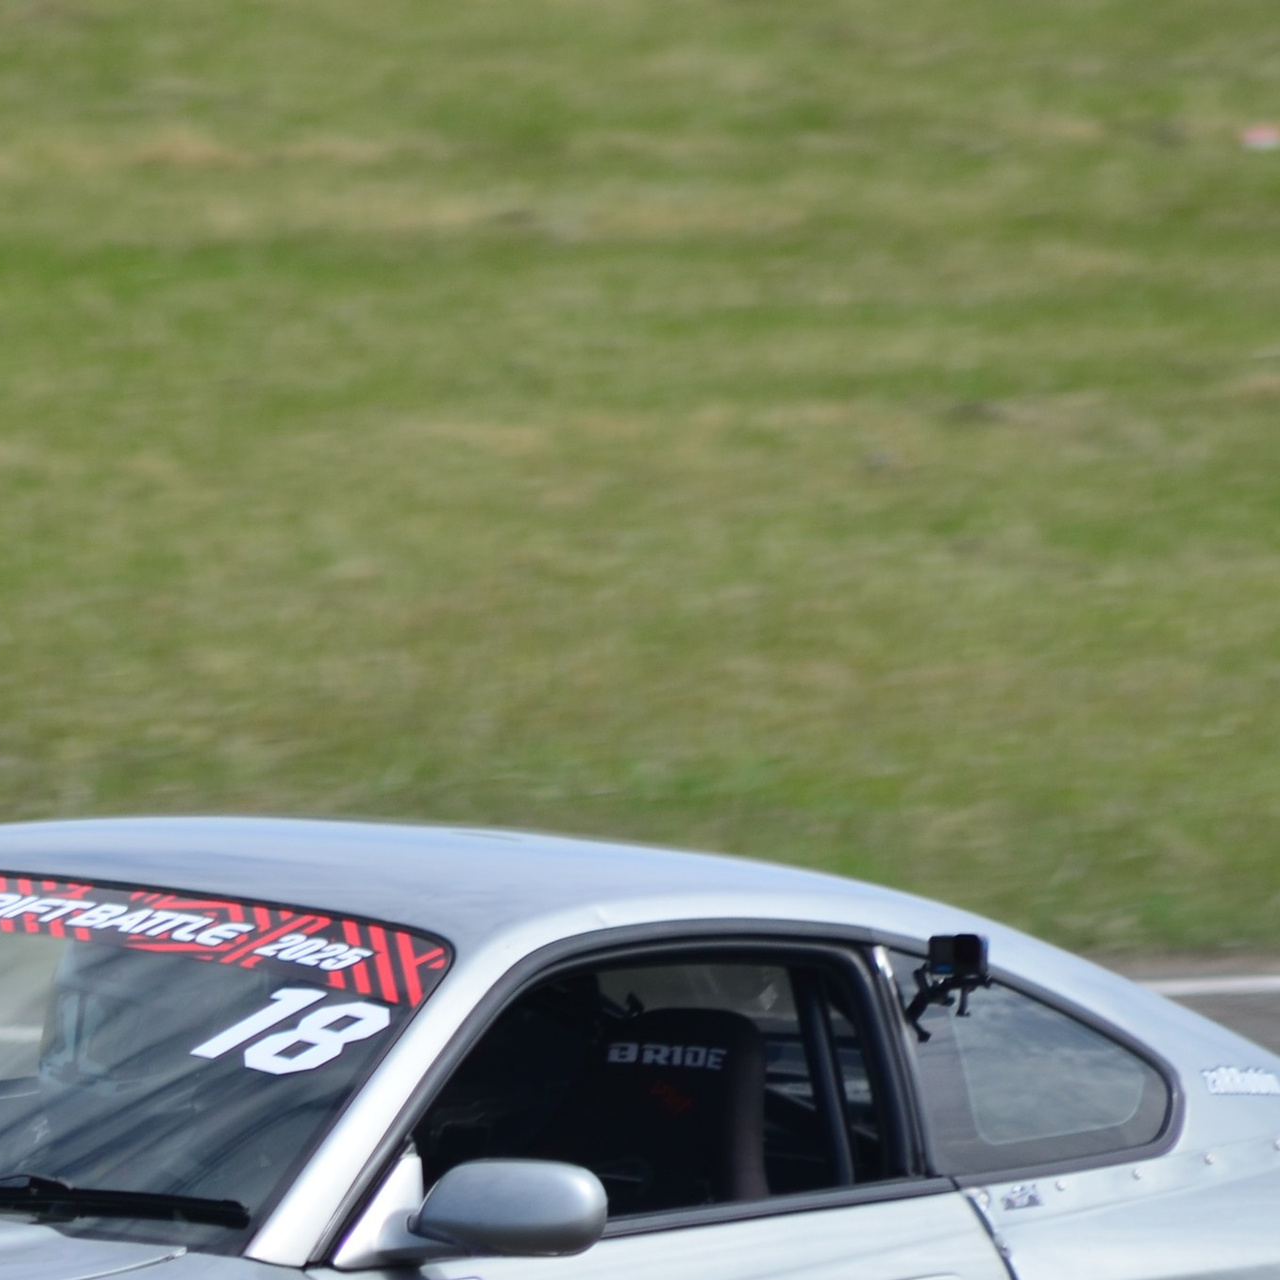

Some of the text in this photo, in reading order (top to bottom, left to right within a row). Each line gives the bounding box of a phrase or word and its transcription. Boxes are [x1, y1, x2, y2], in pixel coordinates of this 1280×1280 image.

[65, 903, 256, 946] BATTLE
[254, 933, 373, 971] 2025
[190, 988, 390, 1075] 18
[608, 1042, 727, 1069] BRIDE
